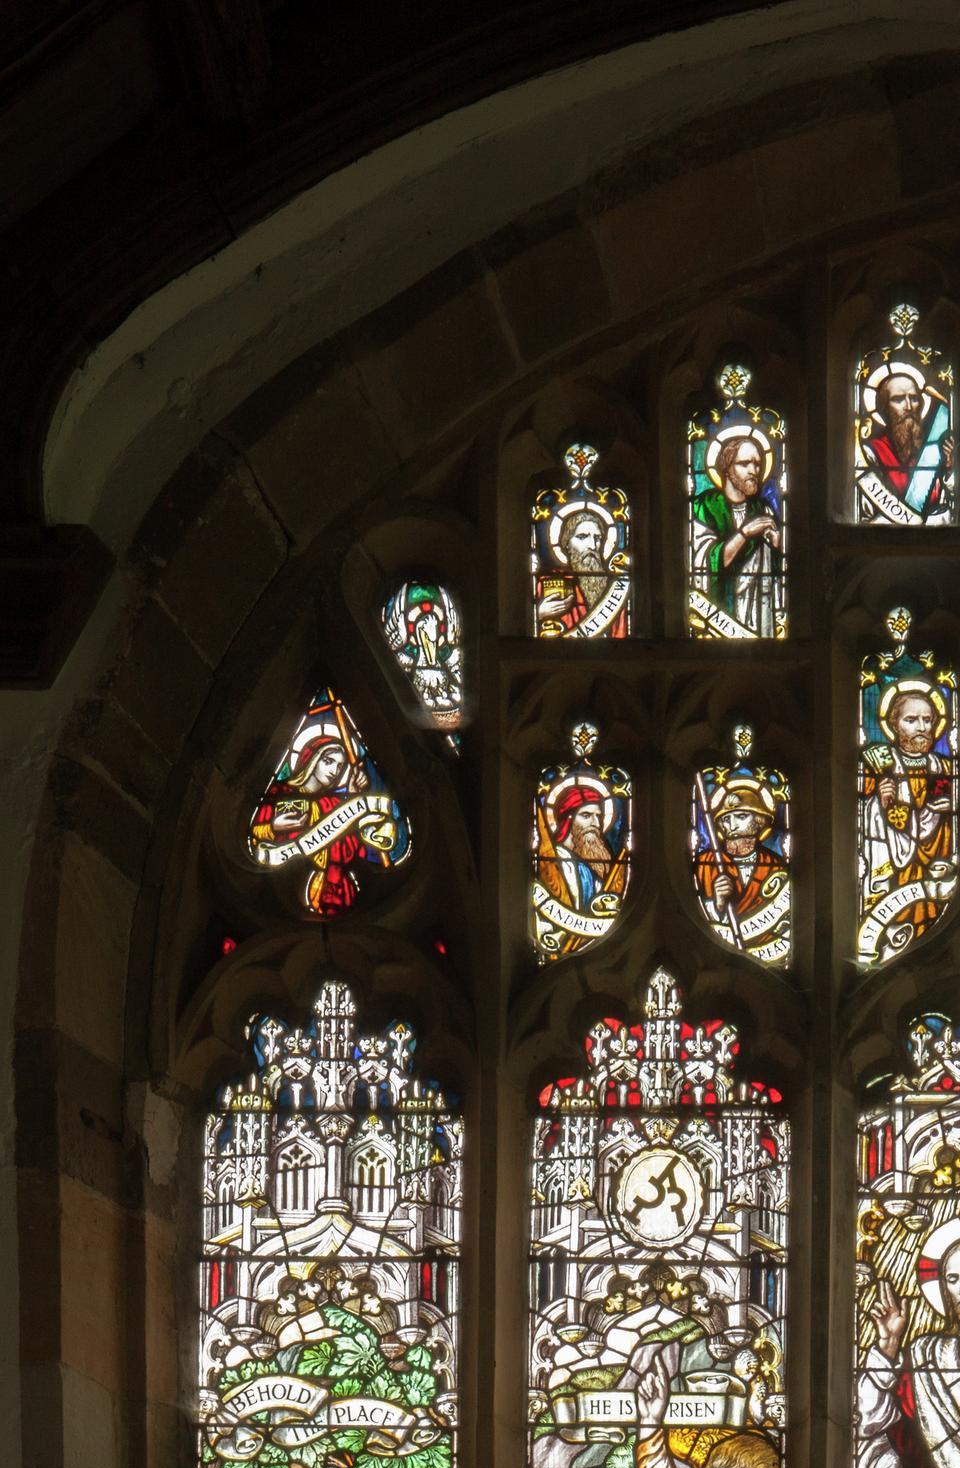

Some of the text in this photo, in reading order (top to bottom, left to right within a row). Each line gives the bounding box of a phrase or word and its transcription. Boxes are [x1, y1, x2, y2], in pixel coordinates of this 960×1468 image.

[868, 482, 914, 523] SIMON
[304, 800, 365, 850] MARCELLA
[545, 904, 604, 932] ANDREW
[877, 887, 921, 919] PETER
[742, 905, 782, 935] JAMES
[230, 1383, 394, 1442] BEHOLD THE PLACE
[589, 1399, 715, 1418] HE IS RISEN
